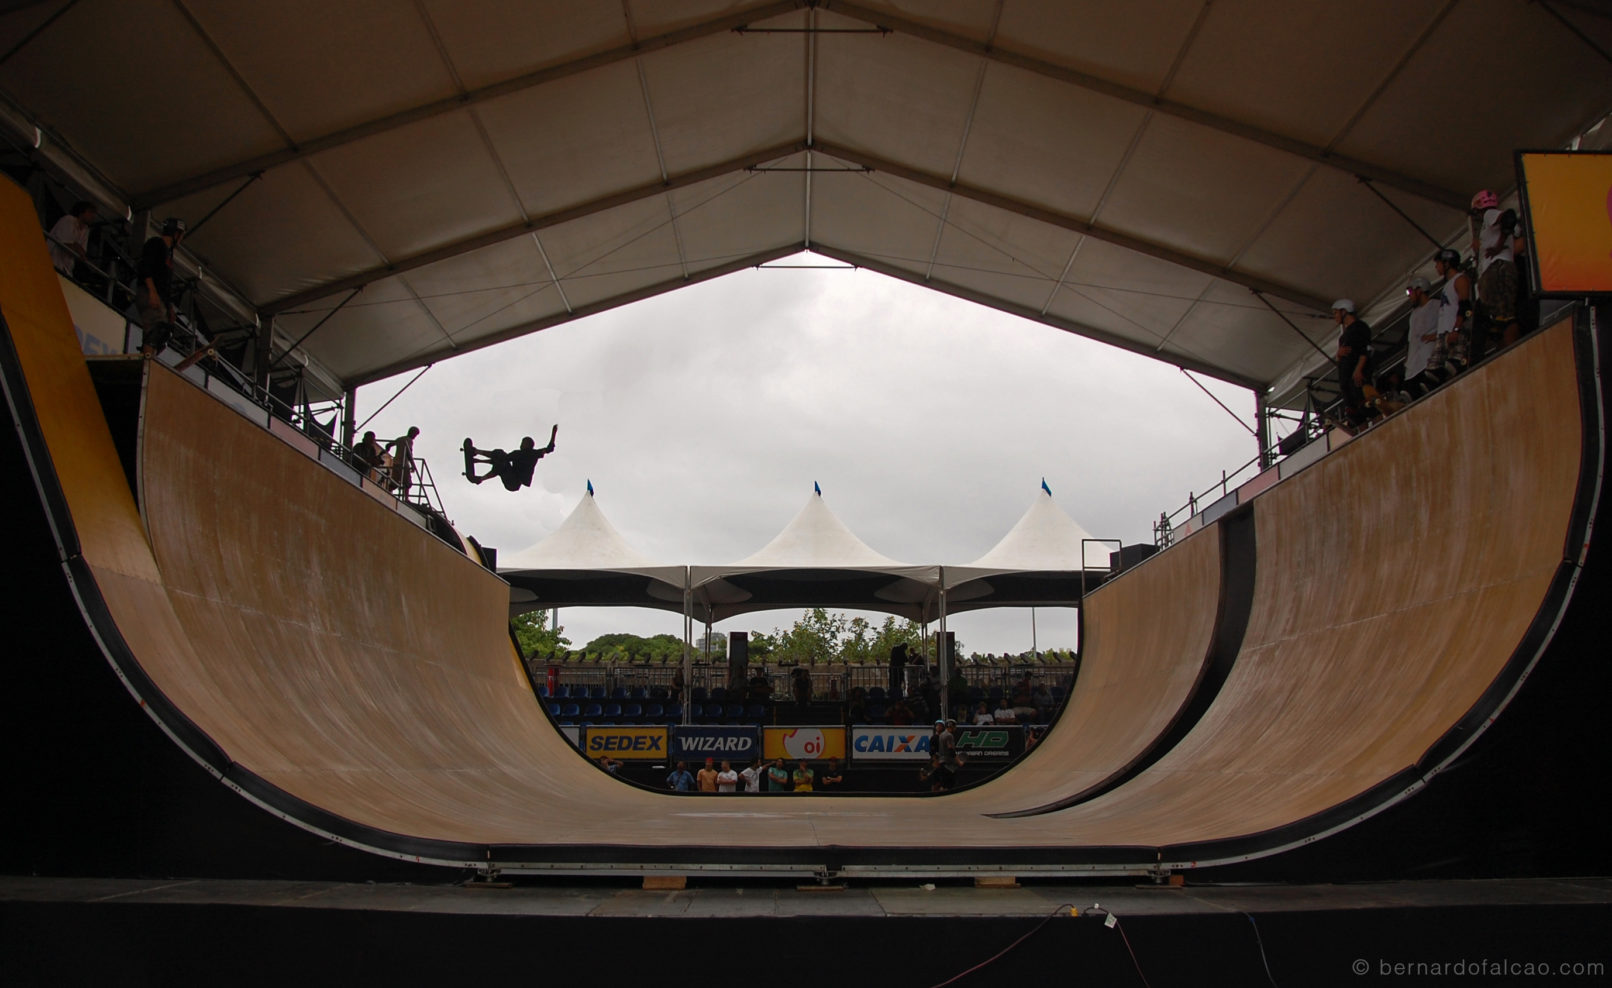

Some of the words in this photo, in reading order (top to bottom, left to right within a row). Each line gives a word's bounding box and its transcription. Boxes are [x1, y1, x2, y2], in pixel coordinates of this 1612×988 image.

[590, 735, 664, 751] SEDEX
[678, 736, 752, 751] WIZARD
[804, 736, 821, 754] oi
[855, 735, 932, 752] CAIXA
[955, 730, 1009, 748] HD
